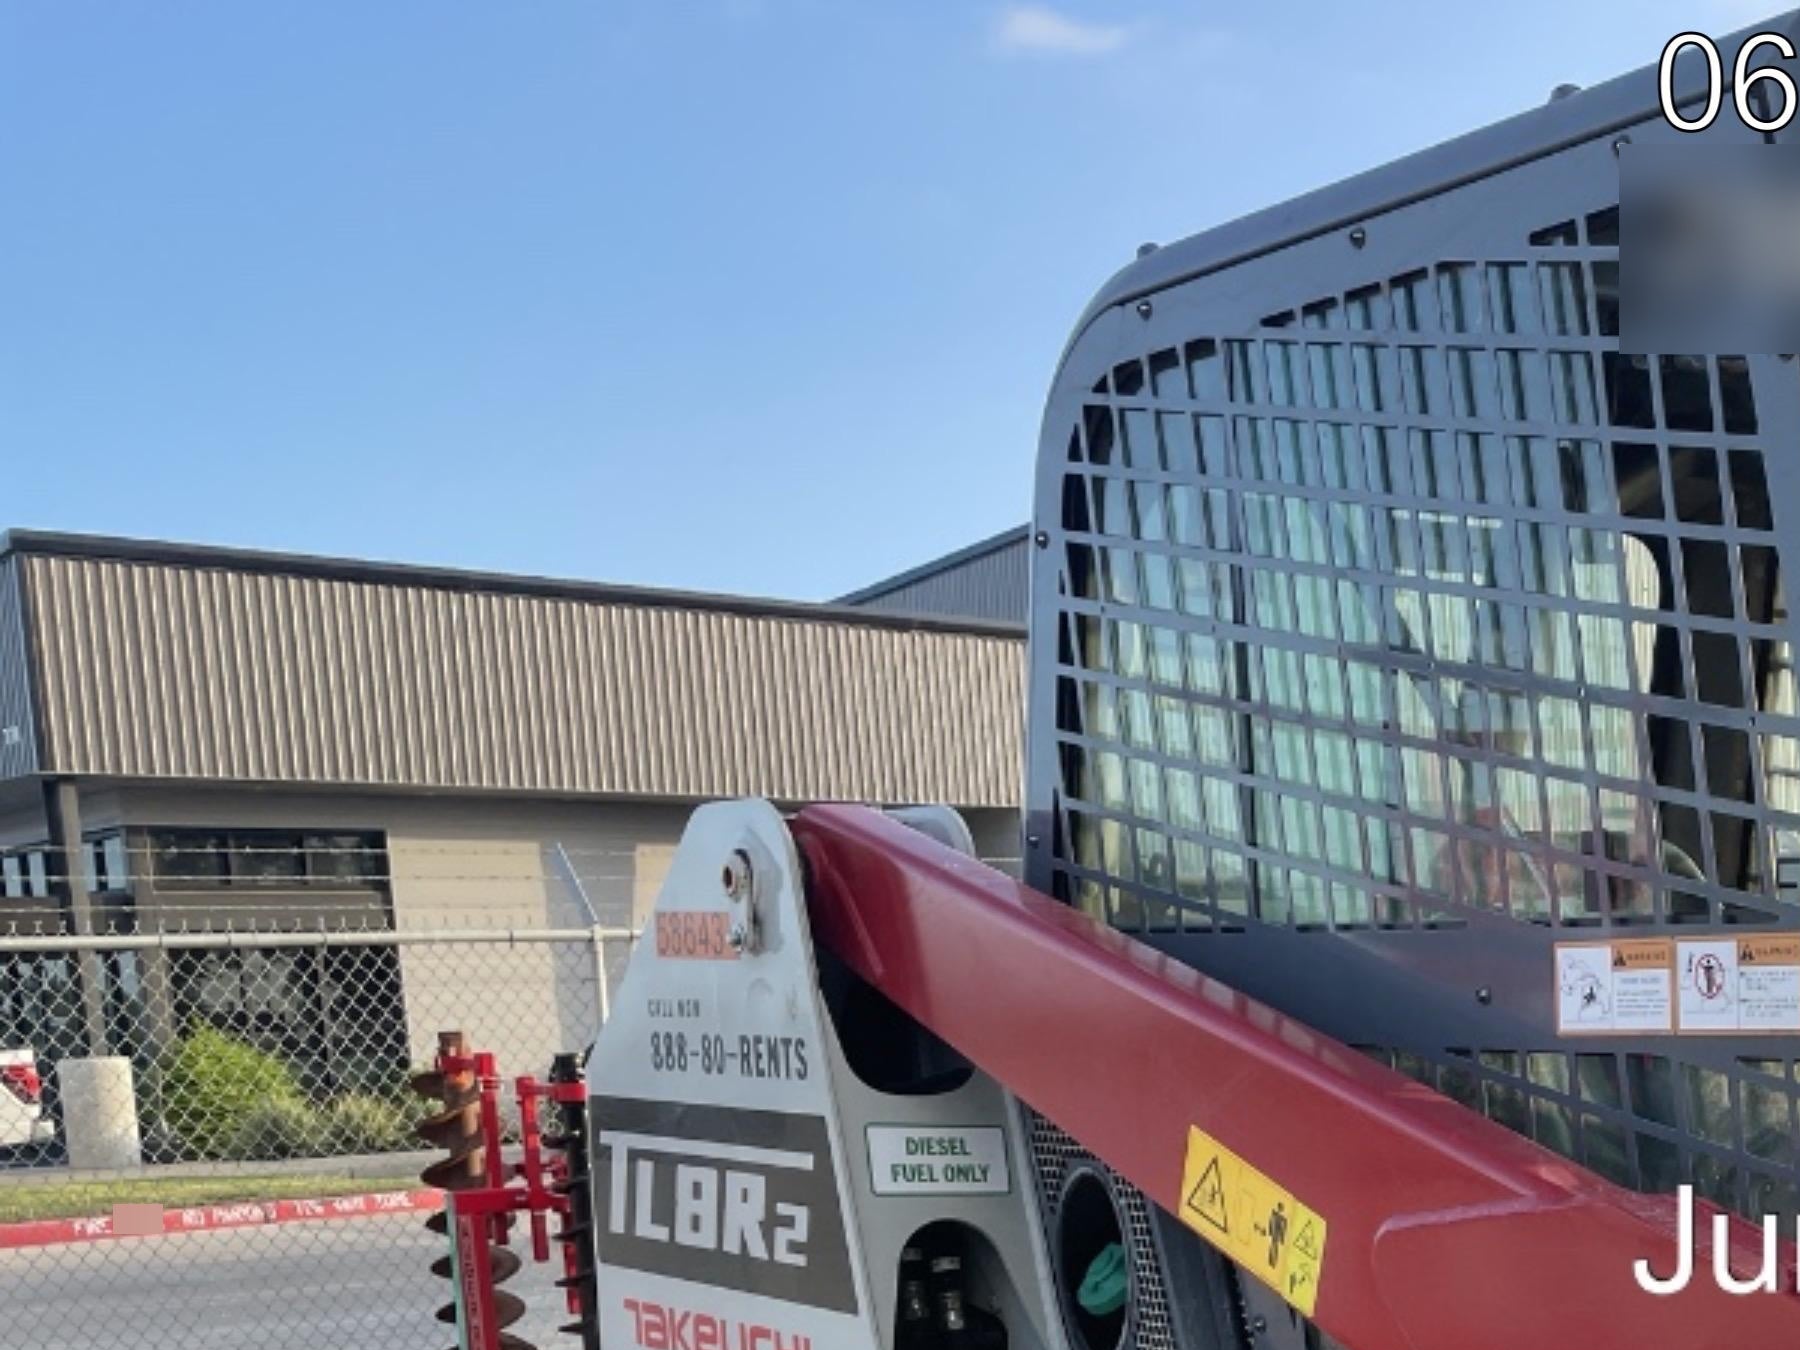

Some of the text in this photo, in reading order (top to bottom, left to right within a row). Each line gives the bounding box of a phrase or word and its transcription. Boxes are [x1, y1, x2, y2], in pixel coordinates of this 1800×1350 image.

[650, 1031, 809, 1081] 888-80-RENTS
[904, 1136, 971, 1157] DIESEL
[890, 1163, 991, 1183] FUEL ONLY
